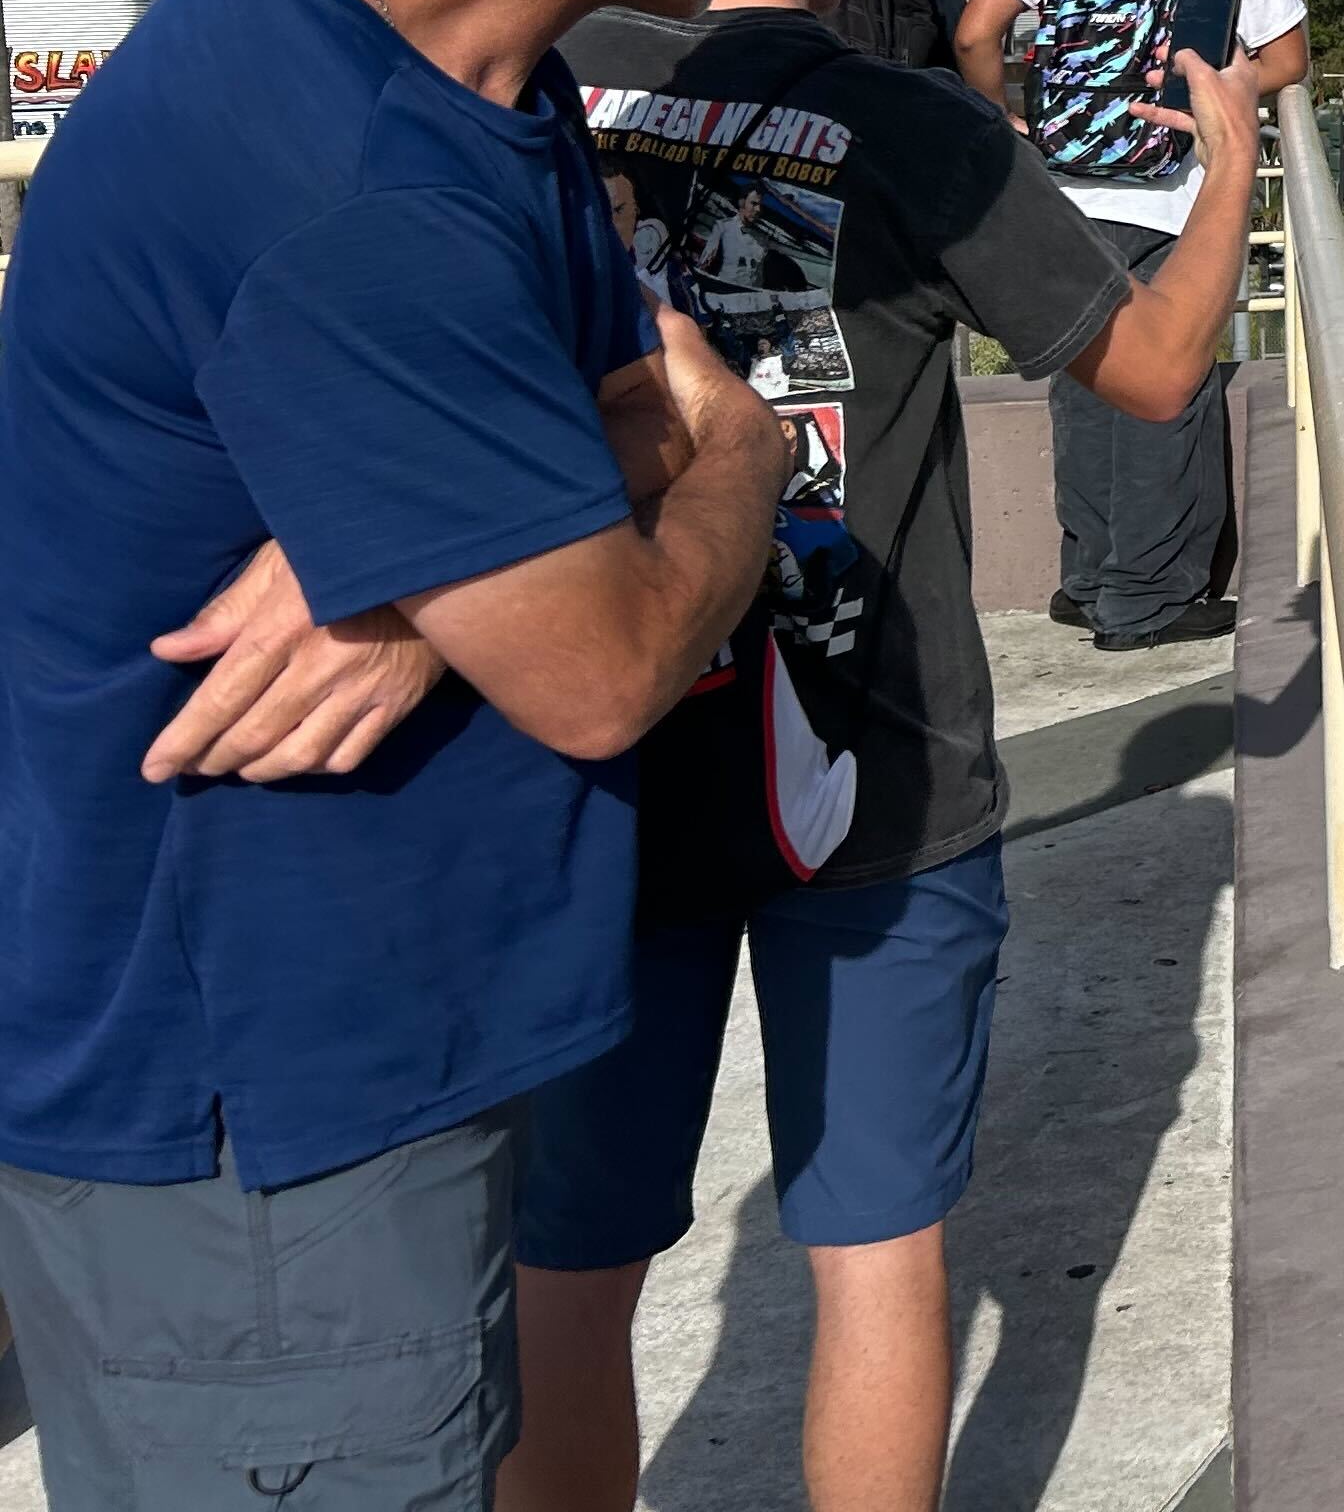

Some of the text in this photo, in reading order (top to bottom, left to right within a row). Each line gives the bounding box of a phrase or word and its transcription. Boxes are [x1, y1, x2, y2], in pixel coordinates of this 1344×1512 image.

[624, 131, 690, 164] BALLAD
[713, 148, 769, 175] RCKY
[772, 156, 838, 187] BOBBY
